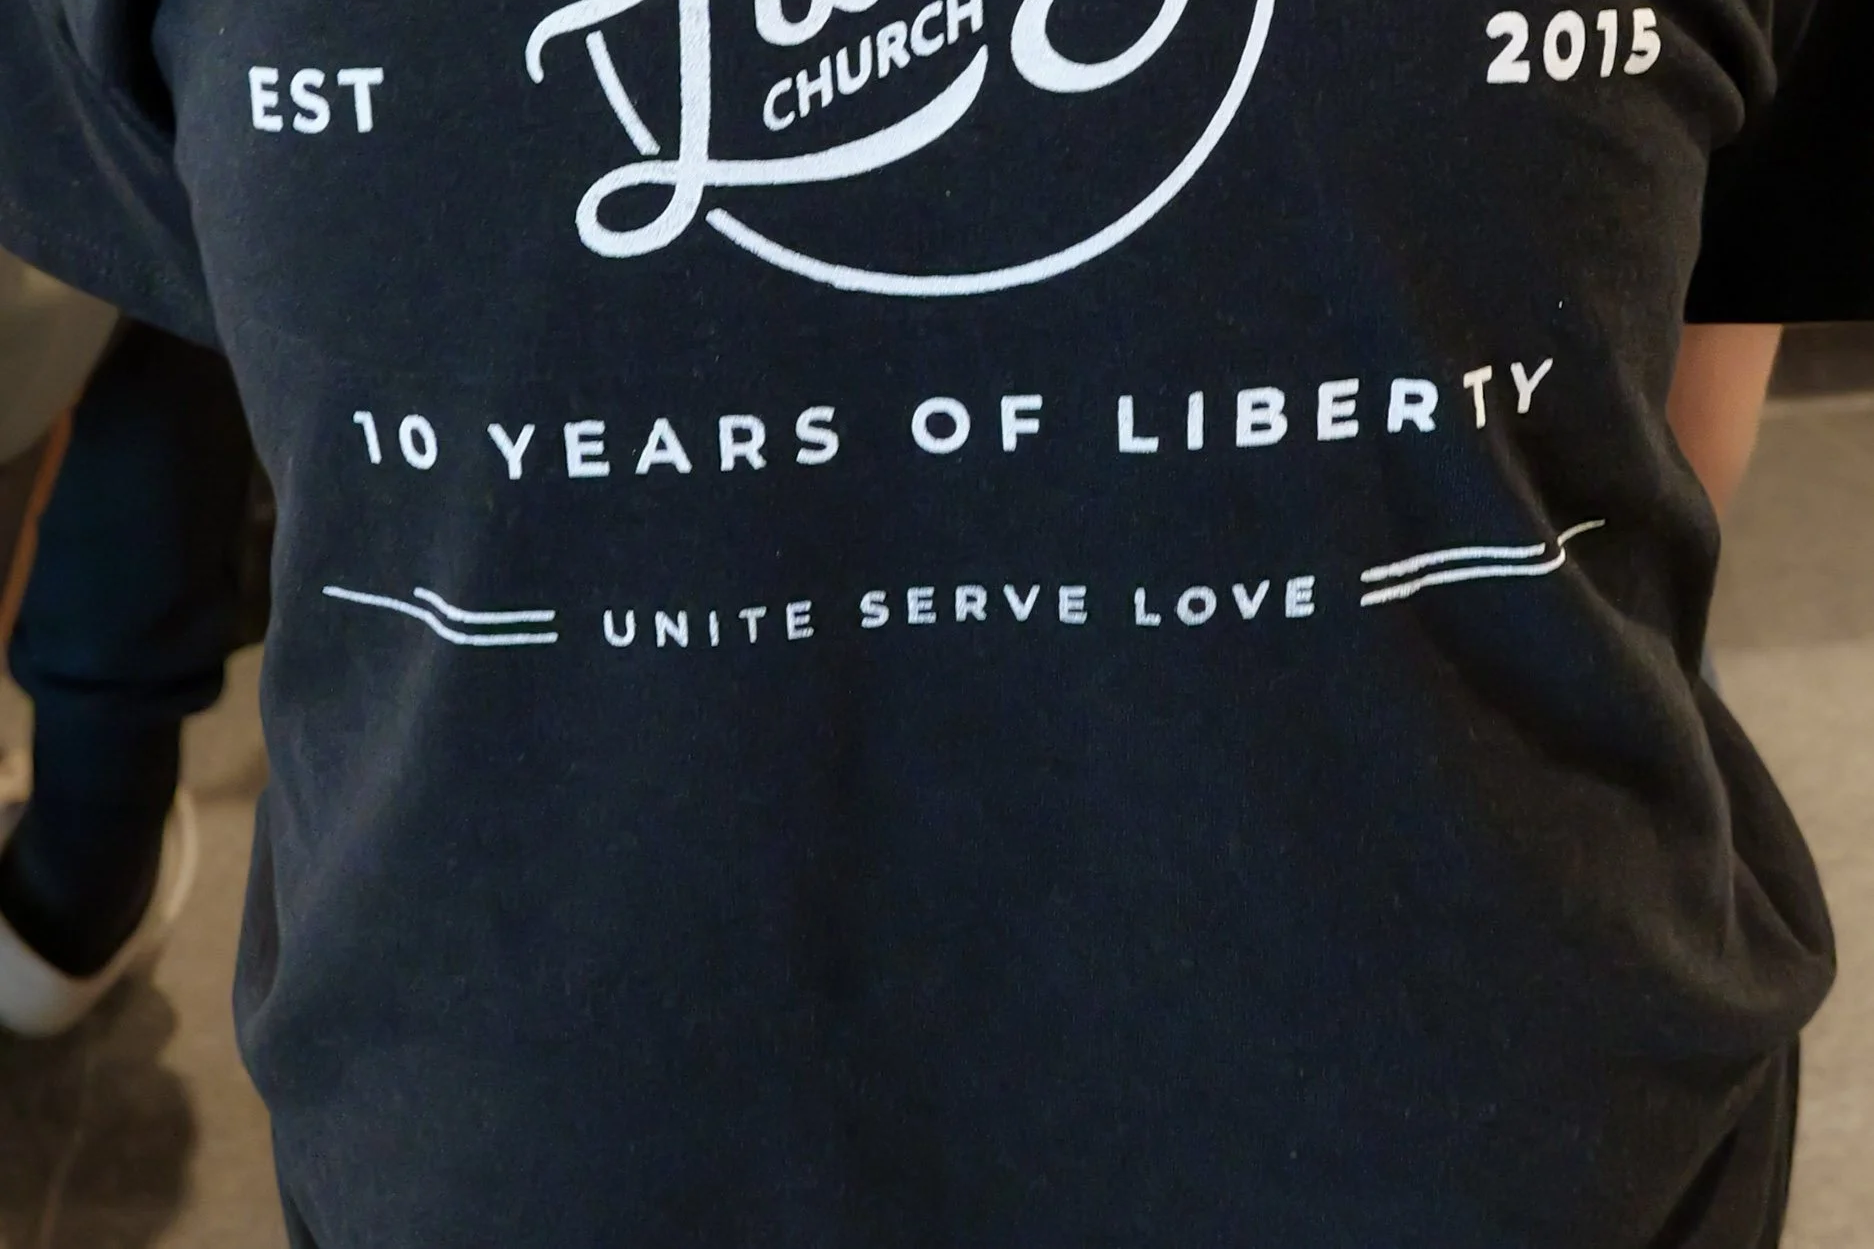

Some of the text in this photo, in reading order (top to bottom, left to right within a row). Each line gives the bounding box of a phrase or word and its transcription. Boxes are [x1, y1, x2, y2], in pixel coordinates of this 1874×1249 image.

[1484, 7, 1662, 84] 2015
[247, 65, 385, 134] EST
[351, 358, 1554, 480] 10 YEARS OF LIBERTY
[603, 575, 1317, 648] UNITE SERVE LOVE
